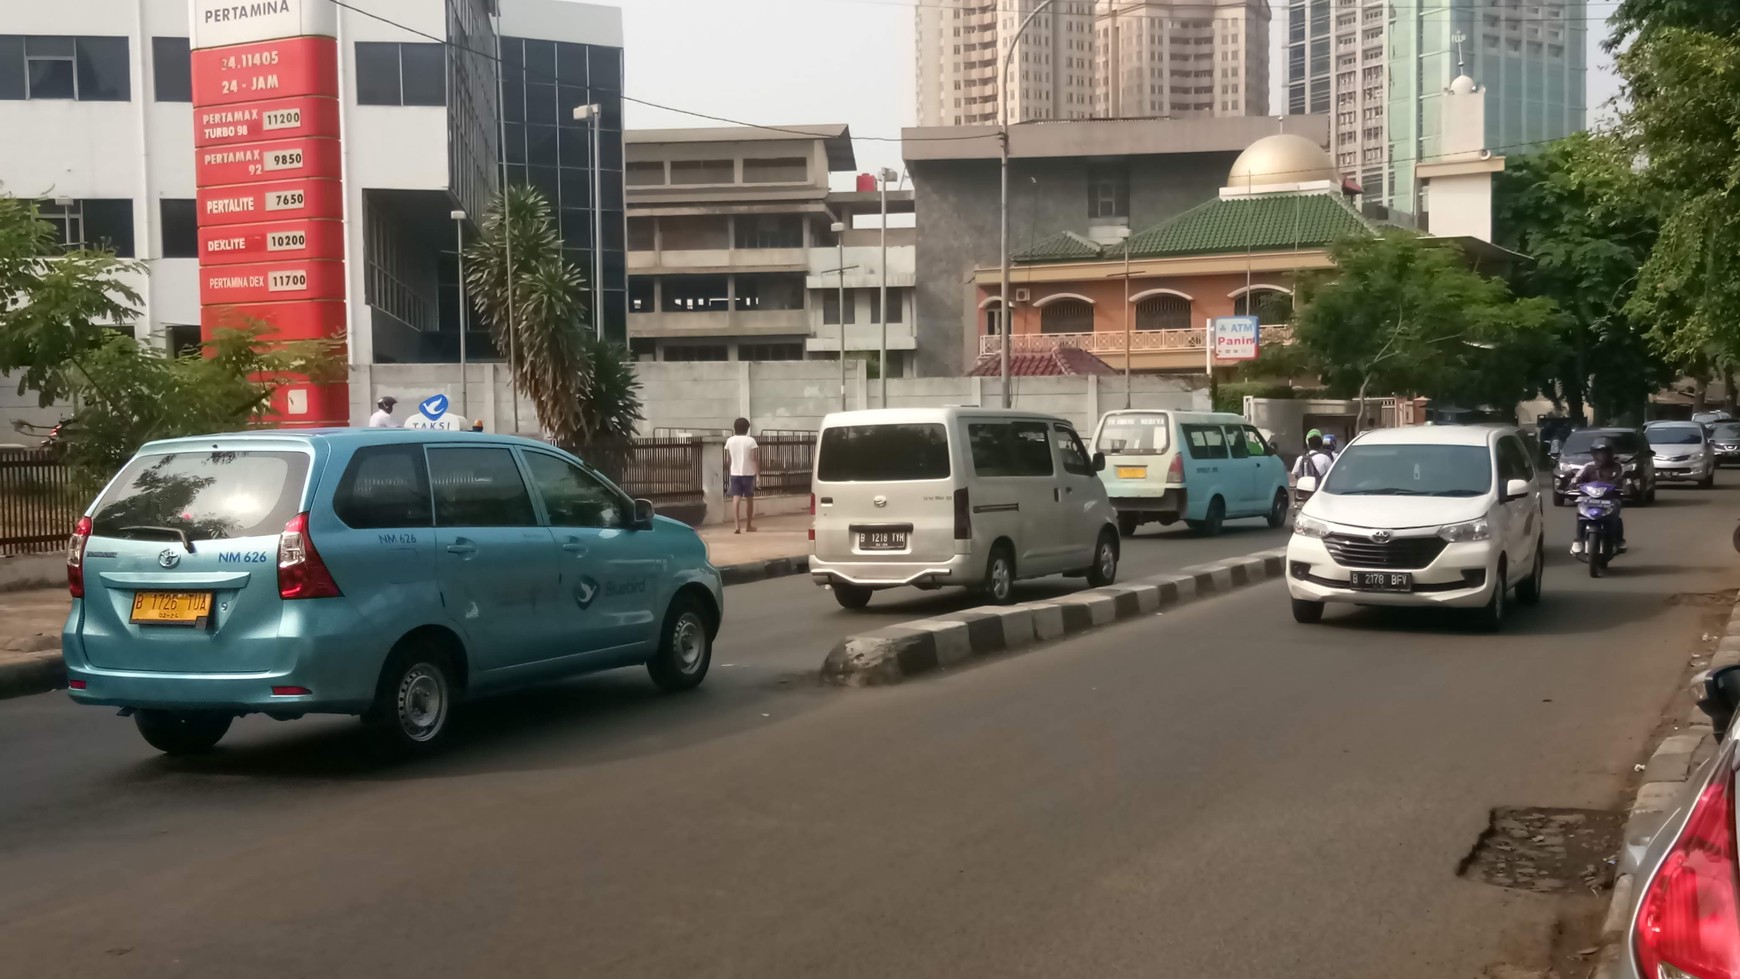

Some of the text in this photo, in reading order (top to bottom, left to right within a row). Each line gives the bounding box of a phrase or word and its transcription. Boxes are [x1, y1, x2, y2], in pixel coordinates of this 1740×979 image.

[205, 0, 289, 23] PERTAMINA
[222, 80, 238, 94] 24
[251, 74, 279, 91] JAM
[203, 109, 300, 125] PERTAMAX 11200
[204, 125, 248, 139] TURBO 98
[204, 149, 302, 166] PERTAMAX 9850
[248, 164, 263, 175] 92
[207, 193, 304, 214] PERTALITE 7650
[207, 235, 305, 252] DEXLITE 10200
[209, 275, 306, 289] PERTAMINA DEX 11700
[1231, 323, 1253, 332] ATM
[413, 421, 450, 430] TAKSI
[378, 533, 416, 544] NM 626
[860, 533, 904, 542] B 1218 TYH
[218, 551, 267, 563] NM 626
[1352, 573, 1407, 585] B 2178 BFV
[135, 593, 207, 611] B 1726 TUA
